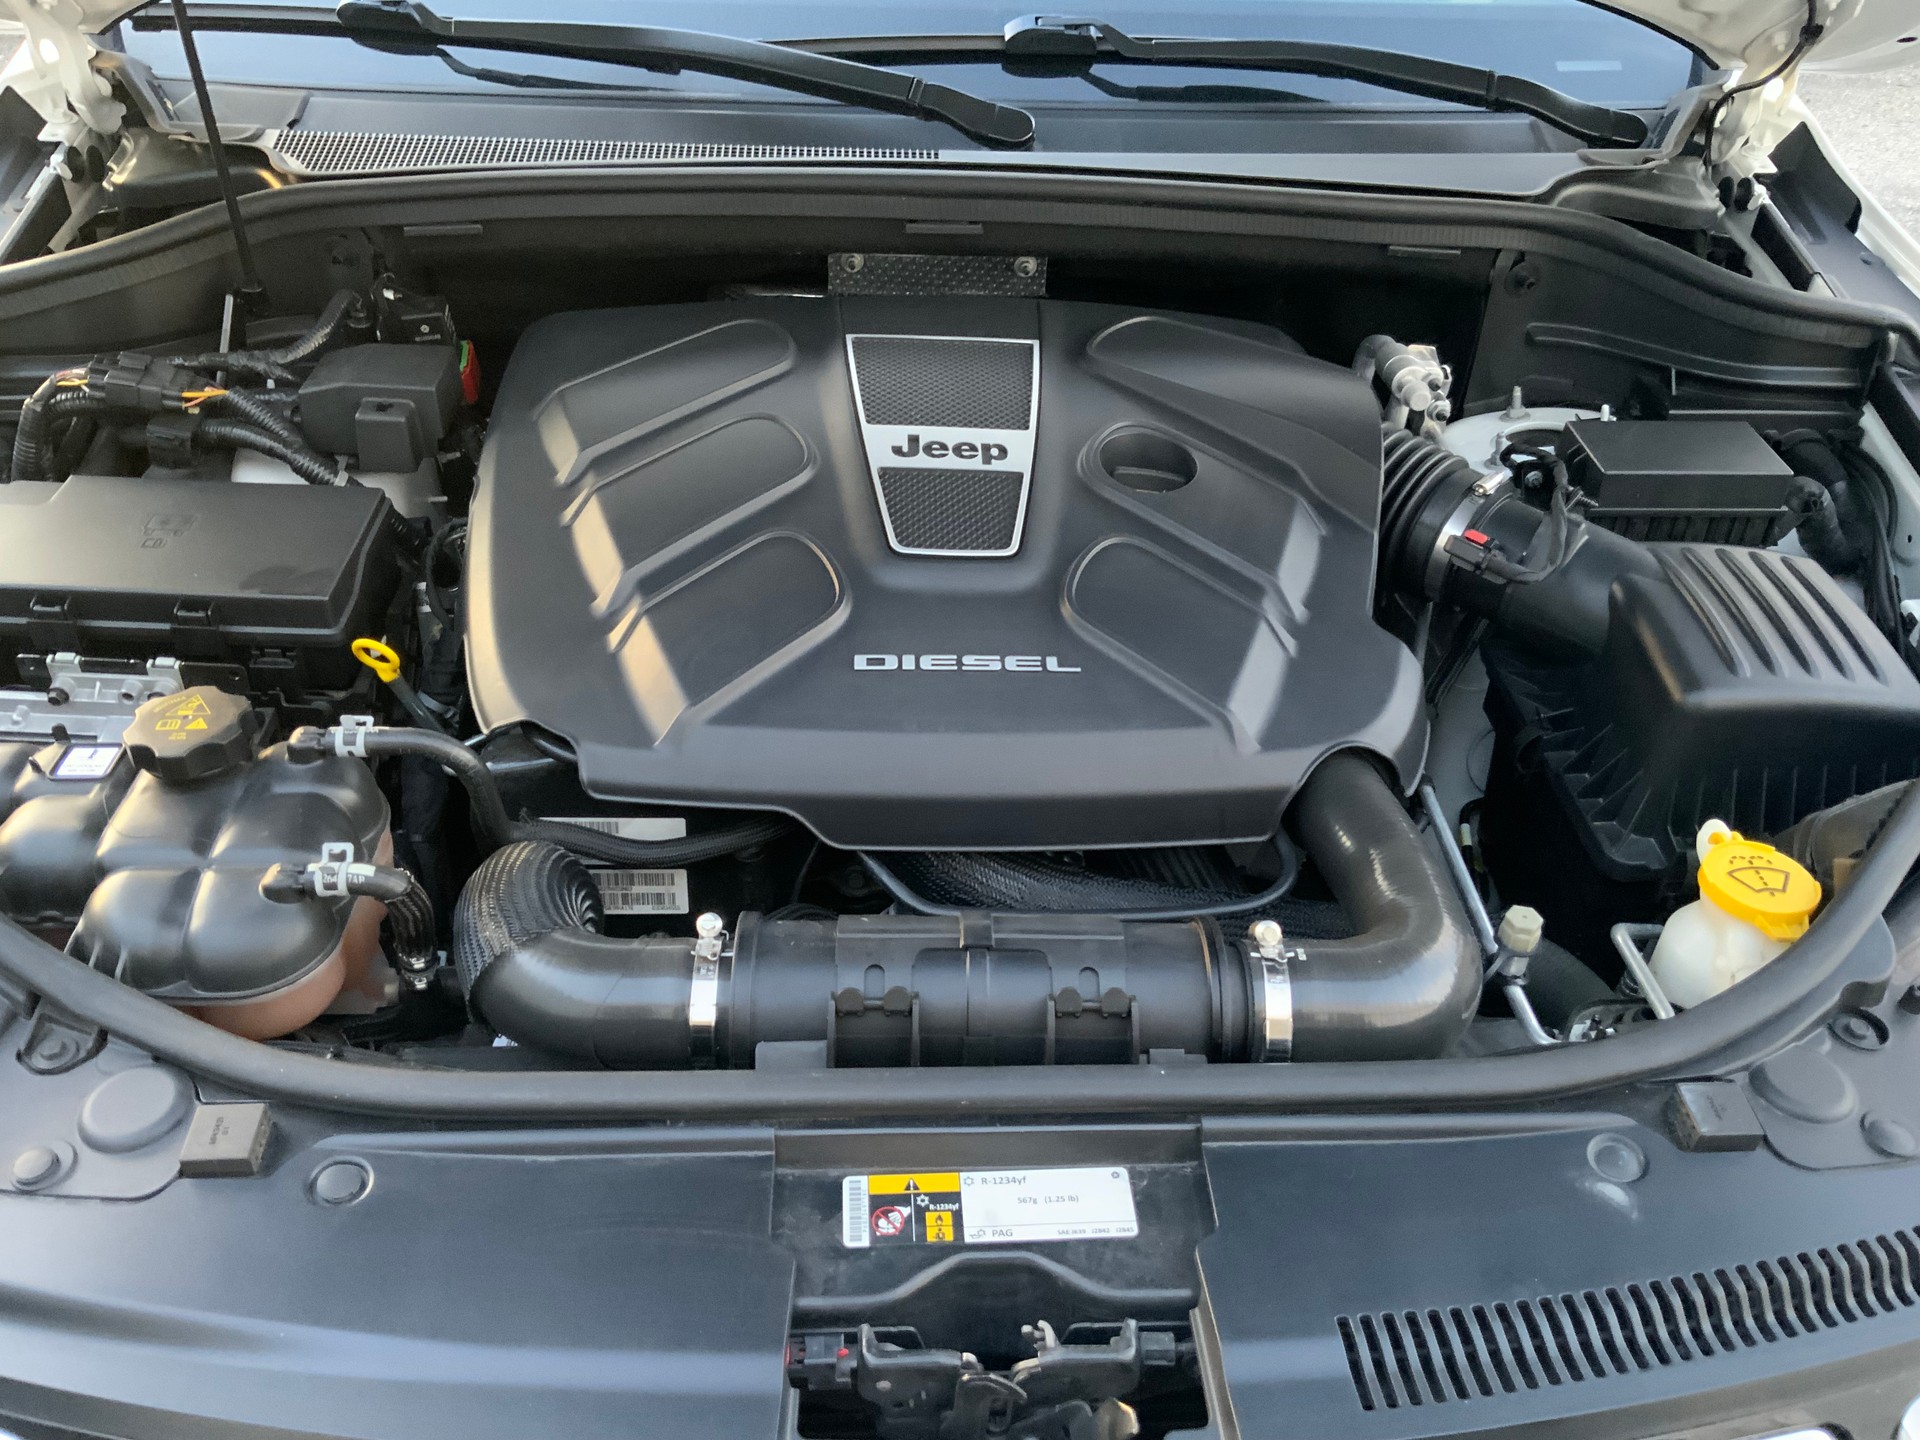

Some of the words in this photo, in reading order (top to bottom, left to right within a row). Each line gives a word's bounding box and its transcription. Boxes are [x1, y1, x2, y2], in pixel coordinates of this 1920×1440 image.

[891, 434, 1009, 466] Jeep
[854, 654, 1082, 673] DIESEL
[980, 1175, 1027, 1186] R-1234yf
[1017, 1196, 1038, 1205] 567g
[1044, 1195, 1066, 1204] (1.25
[1067, 1194, 1080, 1204] lb)
[991, 1228, 1014, 1238] PAG
